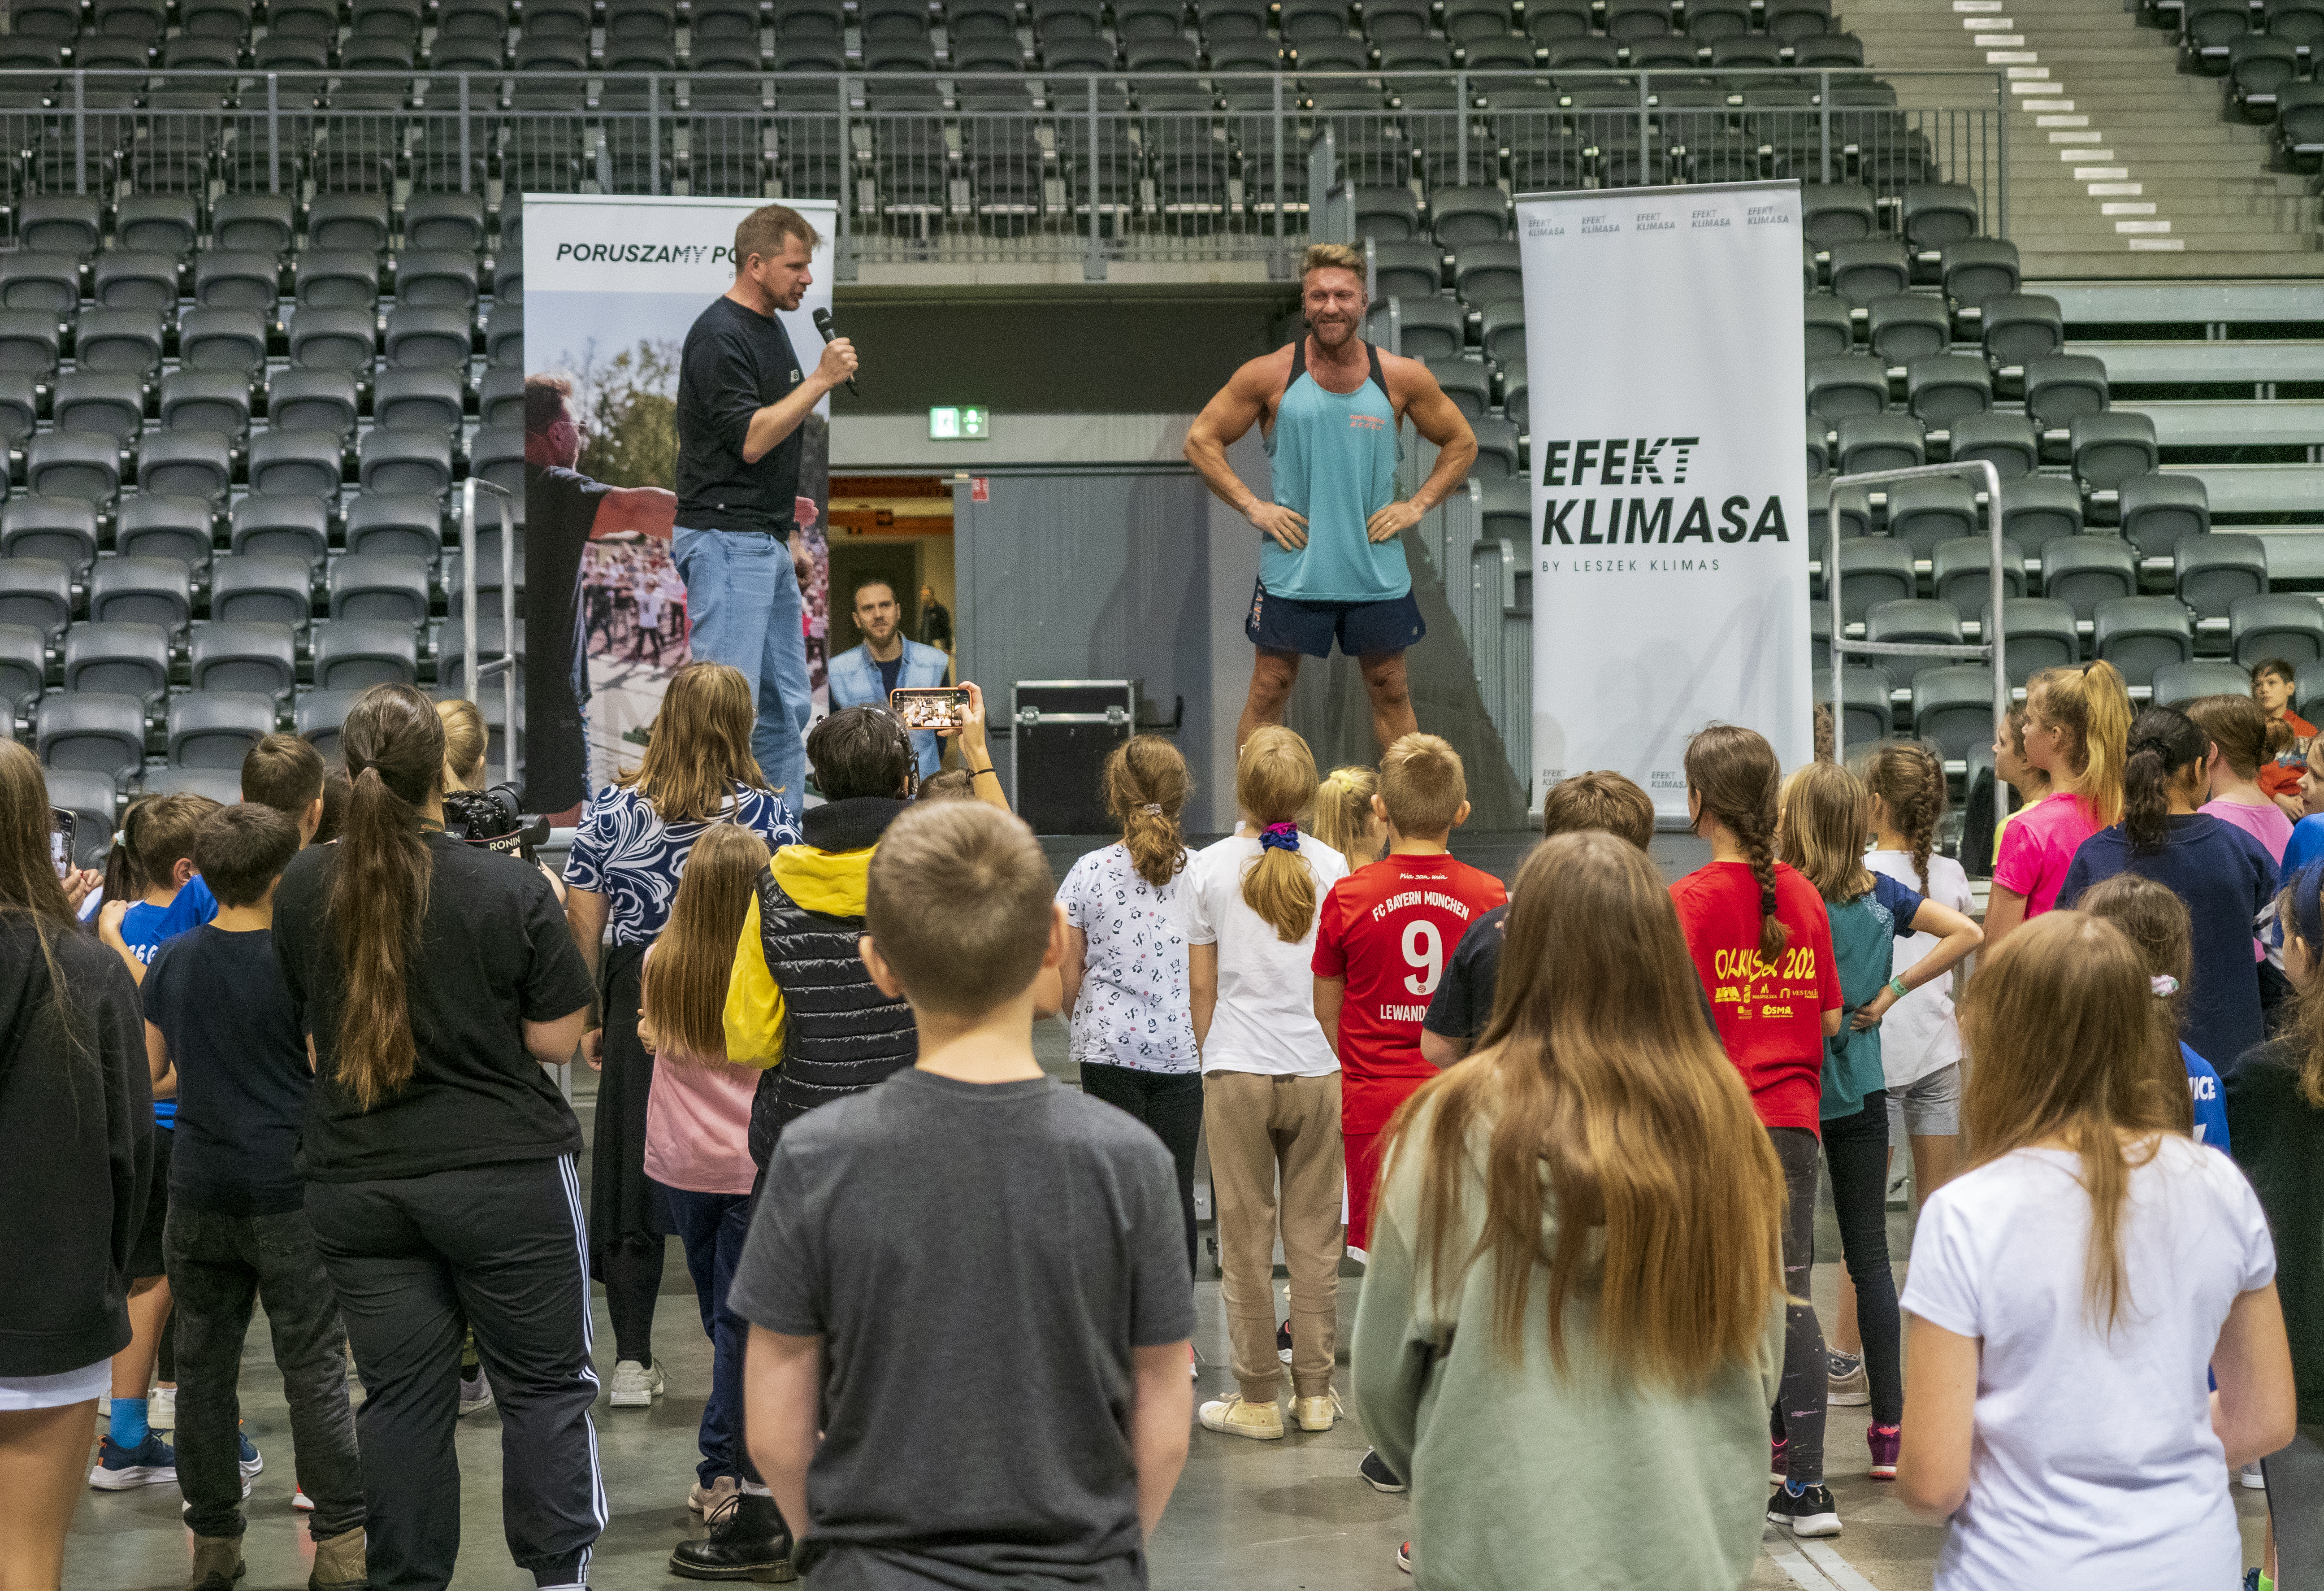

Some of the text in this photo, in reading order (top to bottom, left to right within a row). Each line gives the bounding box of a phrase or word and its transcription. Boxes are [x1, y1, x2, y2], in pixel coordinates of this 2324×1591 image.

[1692, 209, 1717, 218] EFEKT
[1748, 206, 1773, 215] EFEKT
[1582, 215, 1606, 224] EFEKT
[1637, 213, 1661, 221] EFEKT
[1748, 215, 1789, 224] KLIMASA
[1529, 218, 1552, 227] EFEKT
[1637, 221, 1675, 230] KLIMASA
[1692, 217, 1730, 227] KLIMASA
[1529, 227, 1565, 236] KLIMASA
[1582, 224, 1620, 233] KLIMASA
[557, 243, 708, 264] PORUSZAMY
[1543, 436, 1700, 486] EFEKT
[1542, 495, 1790, 545] KLIMASA
[1543, 559, 1720, 572] BY LESZEK KLIMAS
[490, 835, 520, 851] RONIN
[1372, 891, 1469, 922] FC BAYERN MÜNCHEN
[1402, 920, 1443, 995] 9
